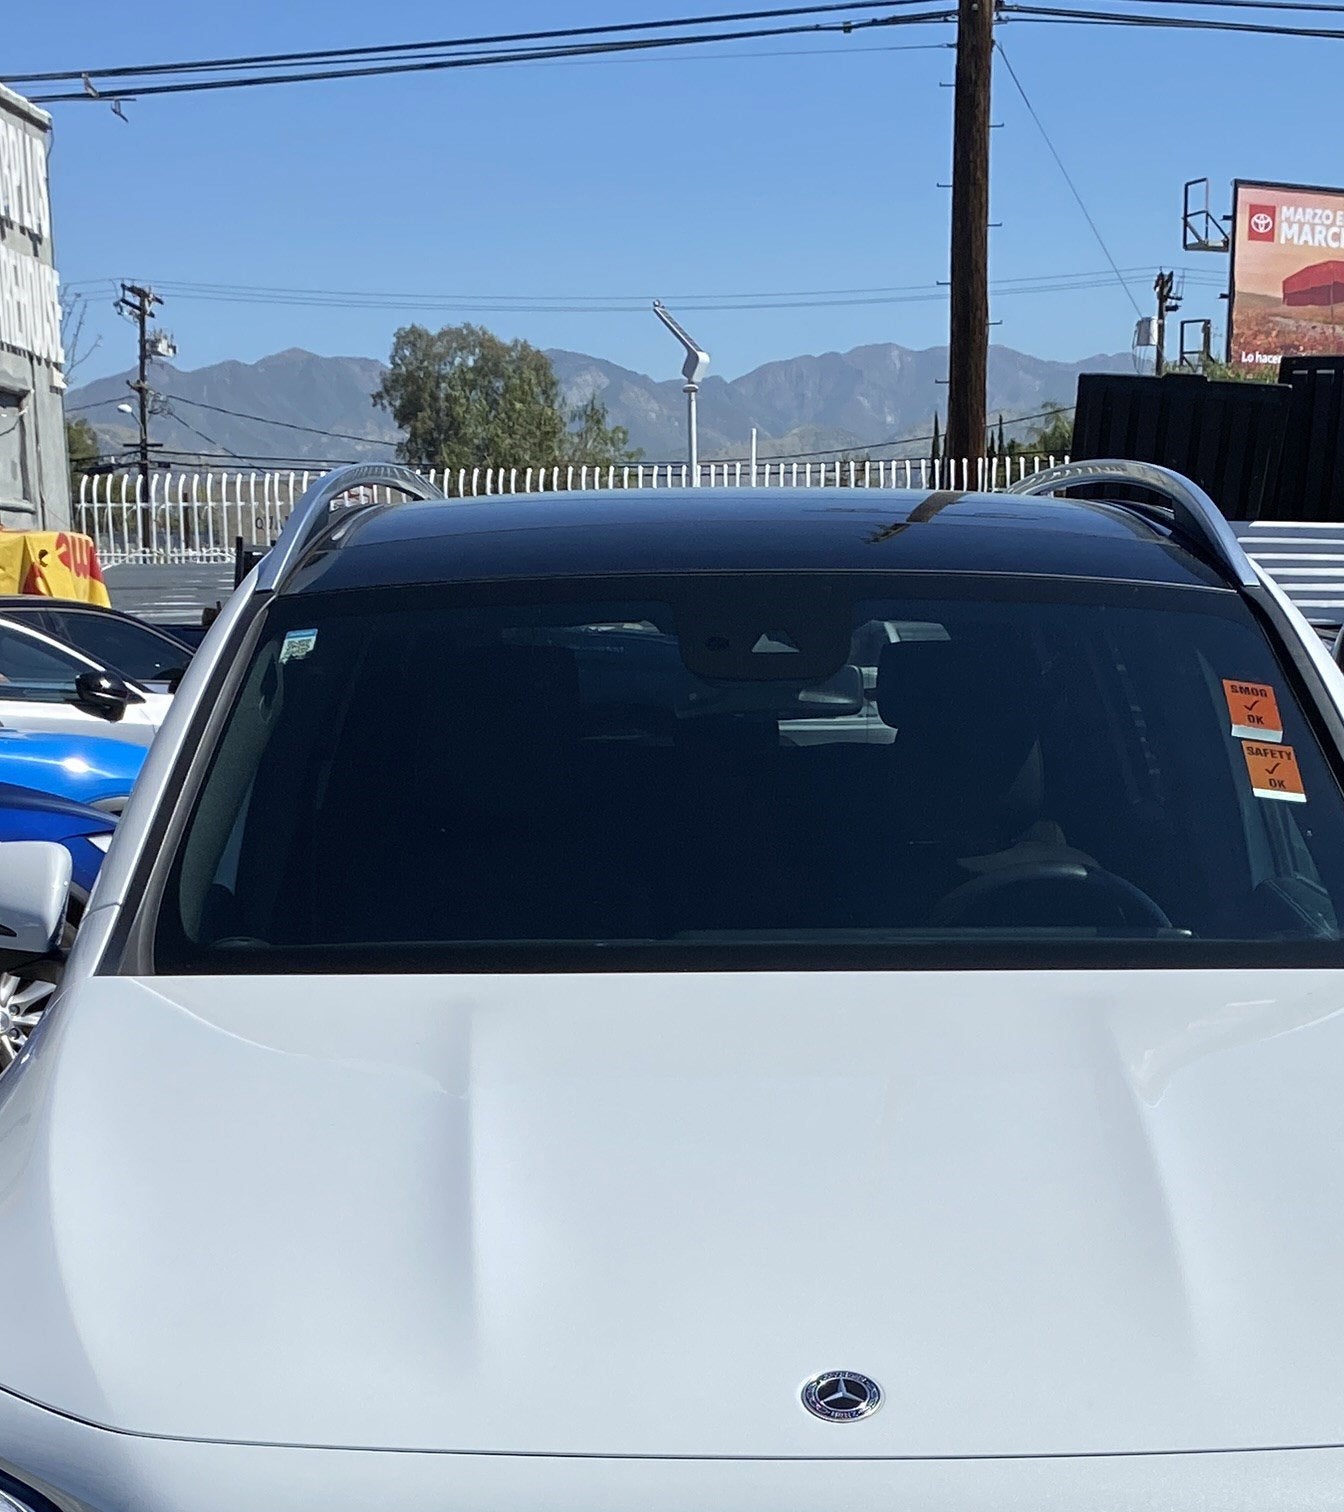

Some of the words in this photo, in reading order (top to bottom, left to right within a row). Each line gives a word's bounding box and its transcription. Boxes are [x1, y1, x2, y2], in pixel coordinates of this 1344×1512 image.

[1281, 205, 1333, 225] MARZO
[1241, 351, 1254, 363] Lo
[1247, 714, 1264, 725] OK
[1247, 746, 1292, 761] SAFETY
[1269, 778, 1286, 789] OK
